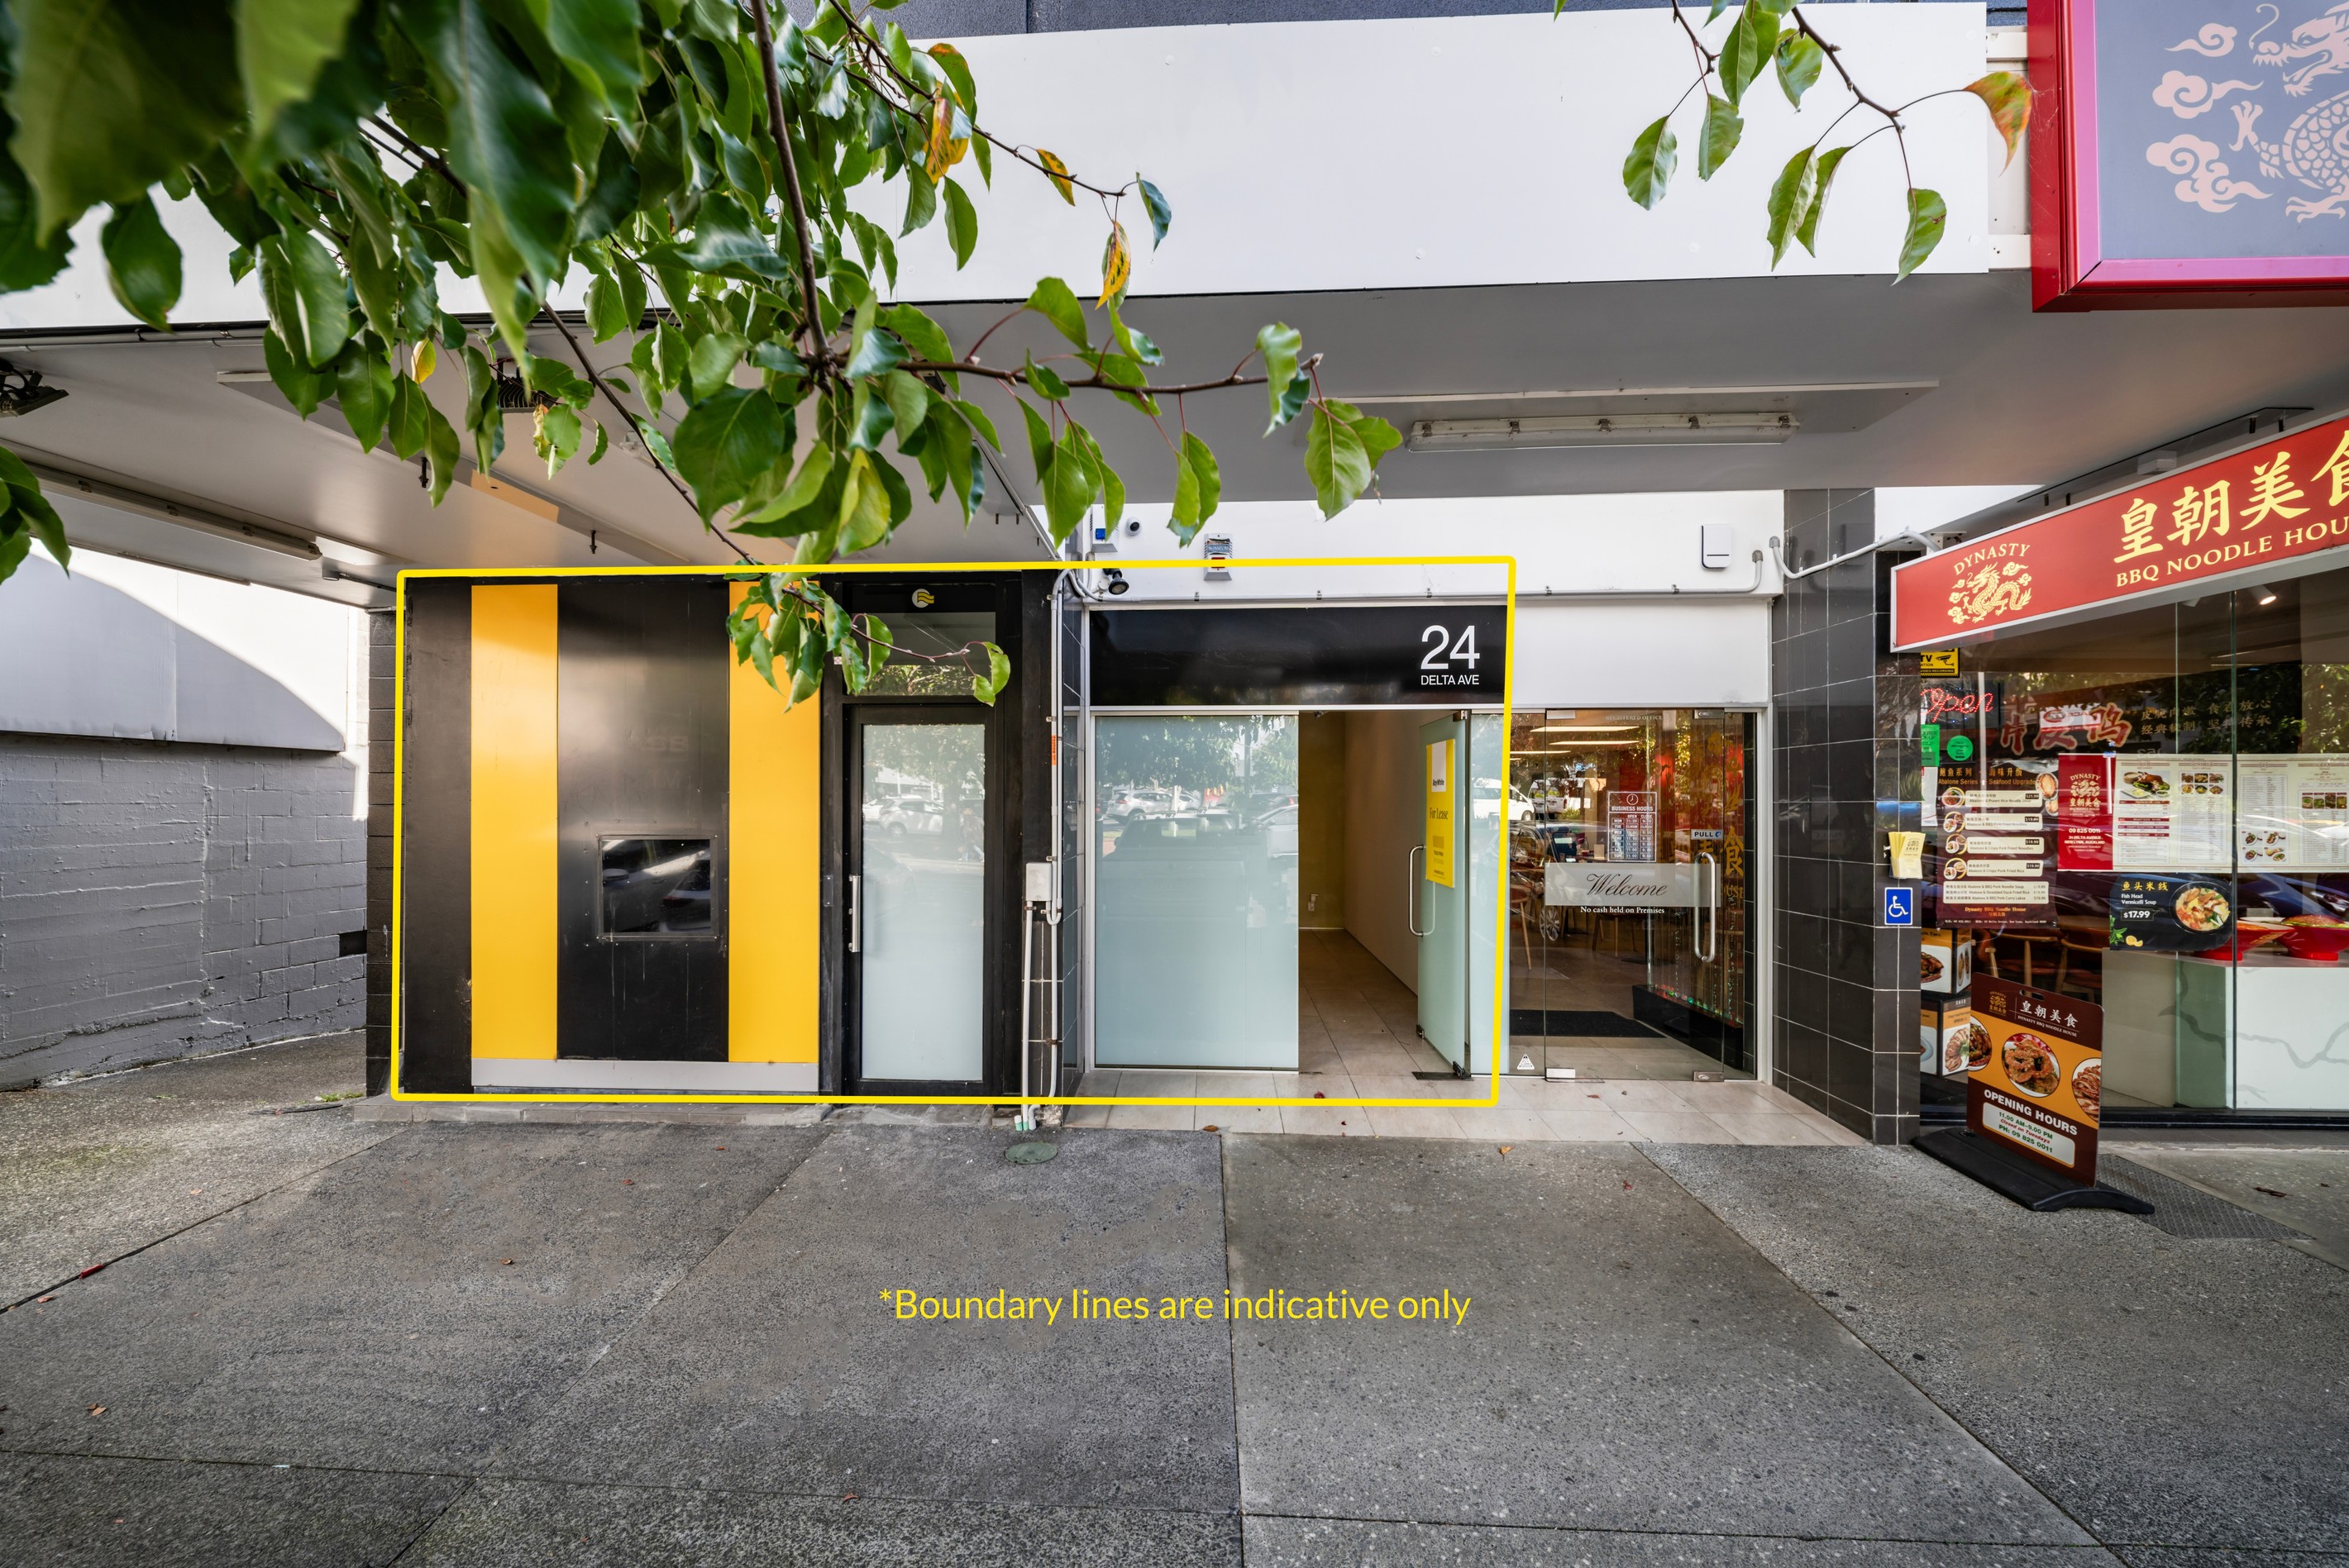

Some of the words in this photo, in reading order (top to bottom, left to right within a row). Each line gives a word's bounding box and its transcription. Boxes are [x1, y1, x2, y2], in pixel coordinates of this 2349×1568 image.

[1954, 543, 2031, 576] DYNASTY
[2116, 565, 2160, 588] BBQ
[2166, 536, 2273, 576] NOODLE
[1420, 624, 1480, 670] 24
[1420, 674, 1456, 685] DELTA
[1457, 674, 1480, 685] AVE
[1920, 688, 1993, 723] Open
[2070, 773, 2101, 781] DYNASTY
[1436, 808, 1448, 819] Lease
[1587, 873, 1668, 896] Welcome
[2122, 881, 2169, 891] 鱼头米线
[2123, 910, 2151, 918] $17.99
[2017, 1015, 2036, 1024] DYNASTY
[2046, 1023, 2062, 1033] NOODLE
[2063, 1028, 2077, 1037] HOUSE
[2020, 1000, 2079, 1028] 皇朝美食
[1984, 1089, 2032, 1117] OPENING
[2035, 1110, 2078, 1136] HOURS
[1999, 1112, 2013, 1122] 11.00
[2043, 1131, 2053, 1139] PM
[1998, 1124, 2010, 1133] PH:
[2012, 1130, 2021, 1138] 09
[2022, 1135, 2035, 1144] 825
[2036, 1141, 2053, 1153] 0011
[2000, 1118, 2017, 1129] Closed
[2026, 1130, 2051, 1144] Tuesdays
